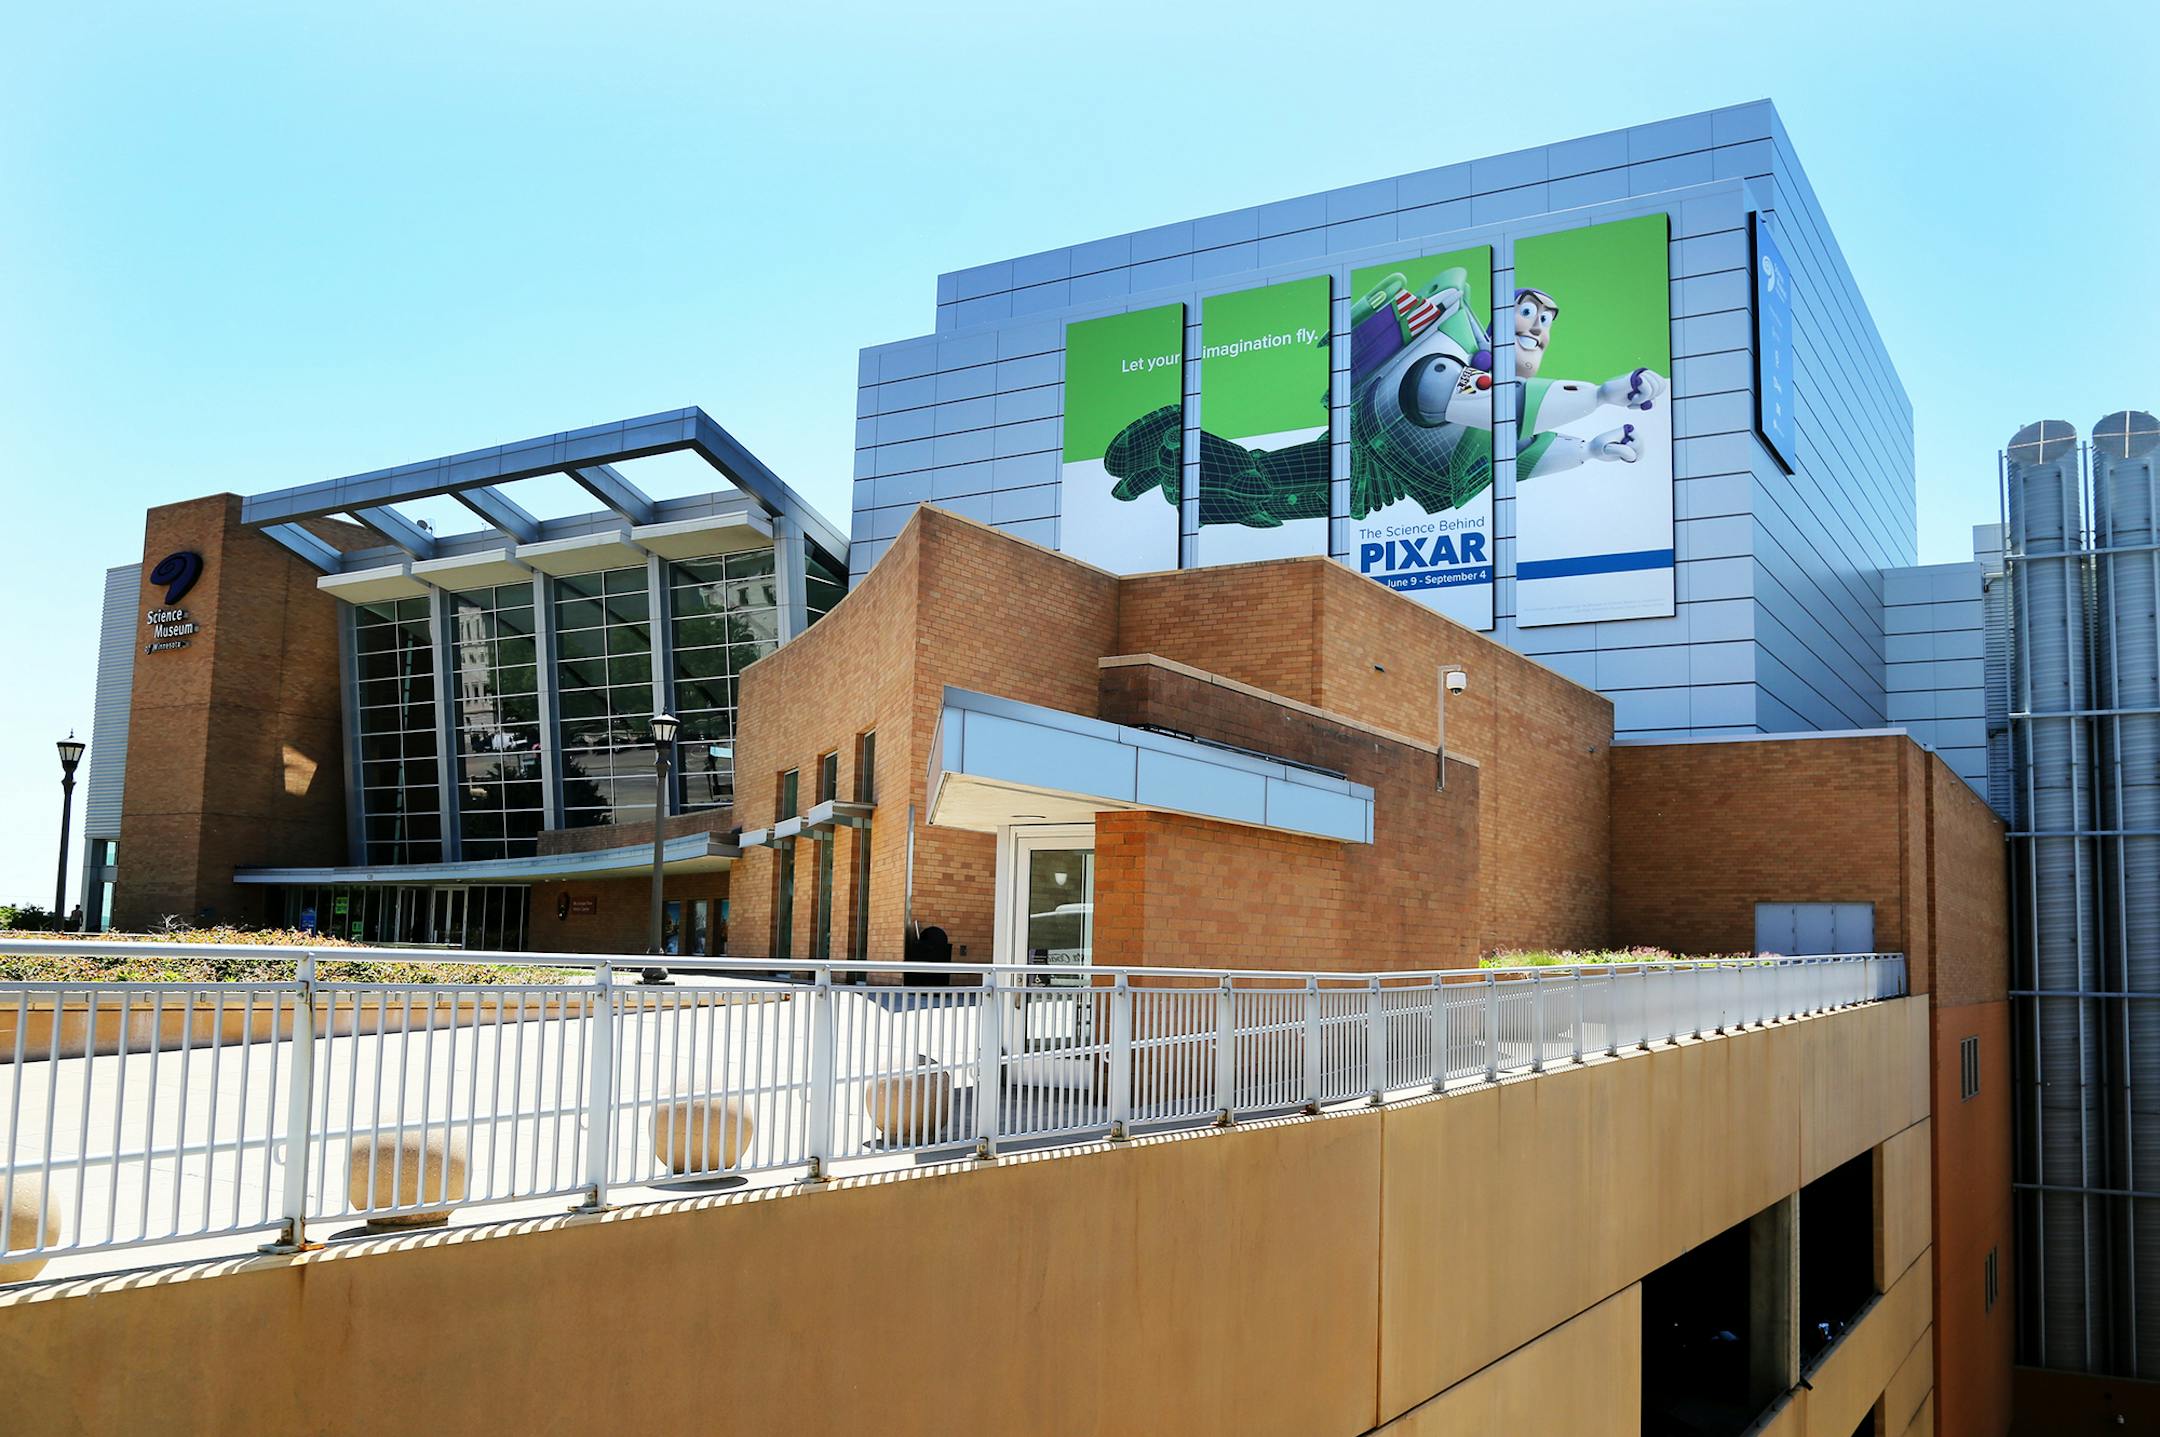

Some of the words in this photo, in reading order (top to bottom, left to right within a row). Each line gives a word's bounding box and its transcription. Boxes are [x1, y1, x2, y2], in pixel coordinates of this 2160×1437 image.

[1122, 358, 1144, 373] Let
[1147, 353, 1181, 372] your
[1202, 333, 1291, 358] imagination
[1296, 327, 1319, 345] fly.
[1359, 527, 1382, 540] The
[1386, 523, 1435, 537] Science
[1439, 516, 1485, 532] Behind
[1361, 532, 1487, 573] PIXAR
[1387, 577, 1408, 588] June
[1410, 576, 1418, 586] 9
[1424, 572, 1477, 585] September
[1479, 570, 1487, 580] 4
[147, 609, 183, 625] Science
[154, 623, 194, 638] Museum
